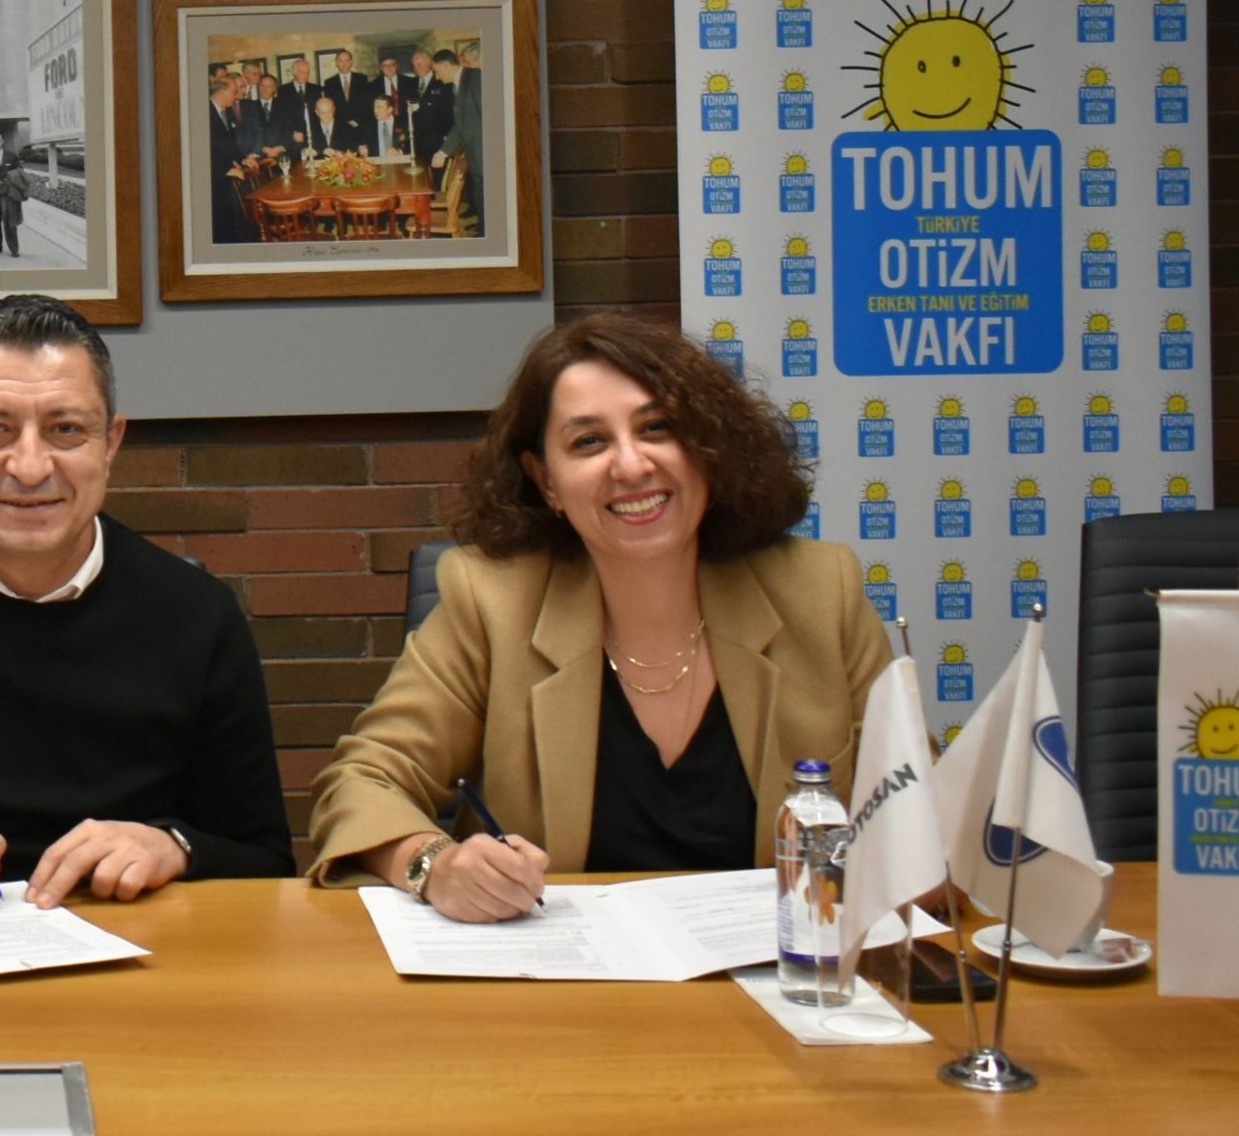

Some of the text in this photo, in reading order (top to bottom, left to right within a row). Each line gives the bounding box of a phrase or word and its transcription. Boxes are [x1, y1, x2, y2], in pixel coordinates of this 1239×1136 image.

[1080, 6, 1113, 17] TOHUM
[1155, 5, 1186, 16] TOHUM
[702, 13, 735, 23] TOHUM
[779, 11, 810, 22] TOHUM
[44, 47, 78, 92] FORD
[1081, 88, 1114, 99] TOHUM
[1157, 87, 1188, 98] TOHUM
[704, 95, 737, 106] TOHUM
[780, 93, 812, 104] TOHUM
[841, 145, 1052, 210] TOHUM
[1082, 170, 1114, 181] TOHUM
[1158, 169, 1189, 180] TOHUM
[705, 177, 738, 188] TOHUM
[782, 175, 813, 186] TOHUM
[1083, 252, 1116, 263] TOHUM
[1159, 251, 1191, 262] TOHUM
[707, 260, 740, 270] TOHUM
[783, 258, 814, 269] TOHUM
[868, 296, 916, 312] ERKEN
[920, 295, 954, 311] TANI
[959, 295, 977, 311] VE
[883, 317, 1015, 366] VAKFI
[1084, 334, 1116, 345] TOHUM
[1161, 333, 1192, 344] TOHUM
[784, 340, 815, 351] TOHUM
[861, 420, 892, 431] TOHUM
[935, 419, 968, 430] TOHUM
[1010, 417, 1042, 428] TOHUM
[1085, 416, 1117, 427] TOHUM
[1162, 415, 1193, 426] TOHUM
[862, 503, 894, 514] TOHUM
[937, 501, 969, 512] TOHUM
[1012, 500, 1044, 510] TOHUM
[938, 583, 970, 594] TOHUM
[939, 665, 972, 676] TOHUM
[1178, 763, 1239, 796] TOH
[1196, 845, 1239, 869] VAK
